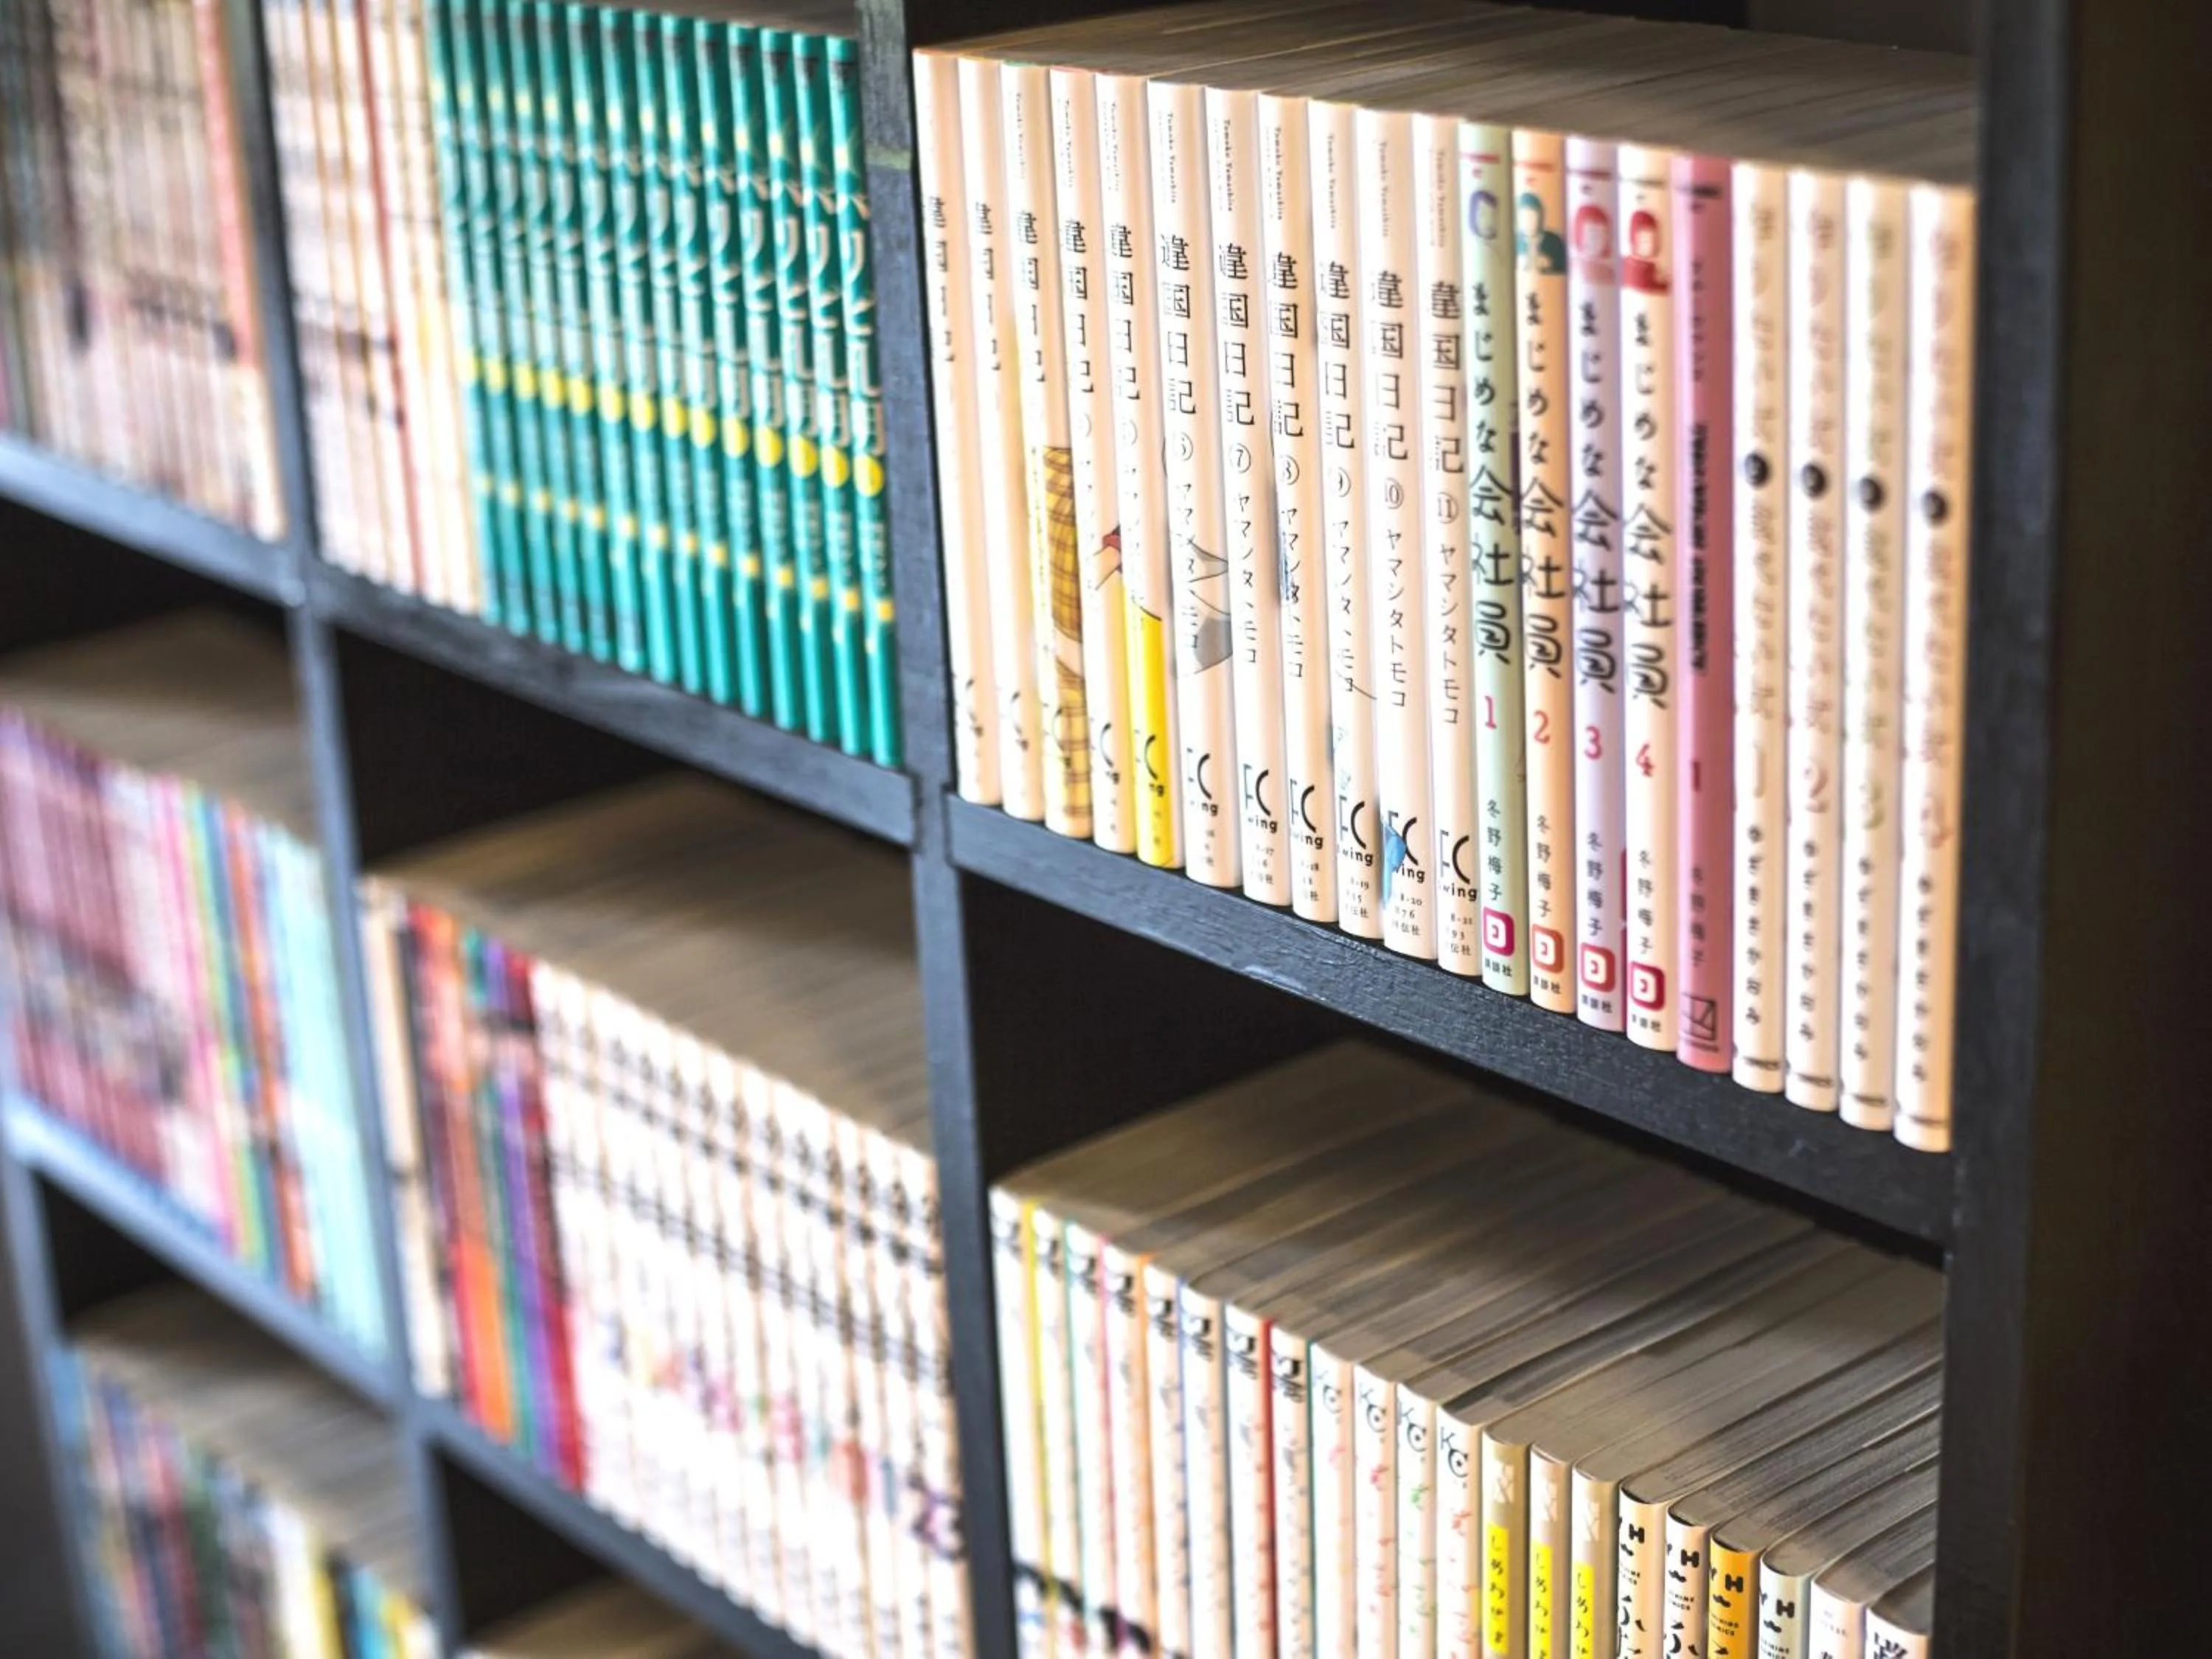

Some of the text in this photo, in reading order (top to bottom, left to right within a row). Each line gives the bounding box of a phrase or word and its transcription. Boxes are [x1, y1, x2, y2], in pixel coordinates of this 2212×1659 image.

[1470, 282, 1513, 664] まじめな会社員
[1521, 293, 1567, 678] まじめな会社員
[1572, 302, 1620, 694] まじめな会社員
[1624, 312, 1673, 710] まじめな会社員
[1386, 529, 1408, 707] ヤマシタトモコ
[1439, 543, 1461, 725] ヤマシタトモコ
[1484, 696, 1496, 730] 1
[1534, 710, 1551, 744] 2
[1584, 726, 1603, 759] 3
[1636, 743, 1655, 778] 4
